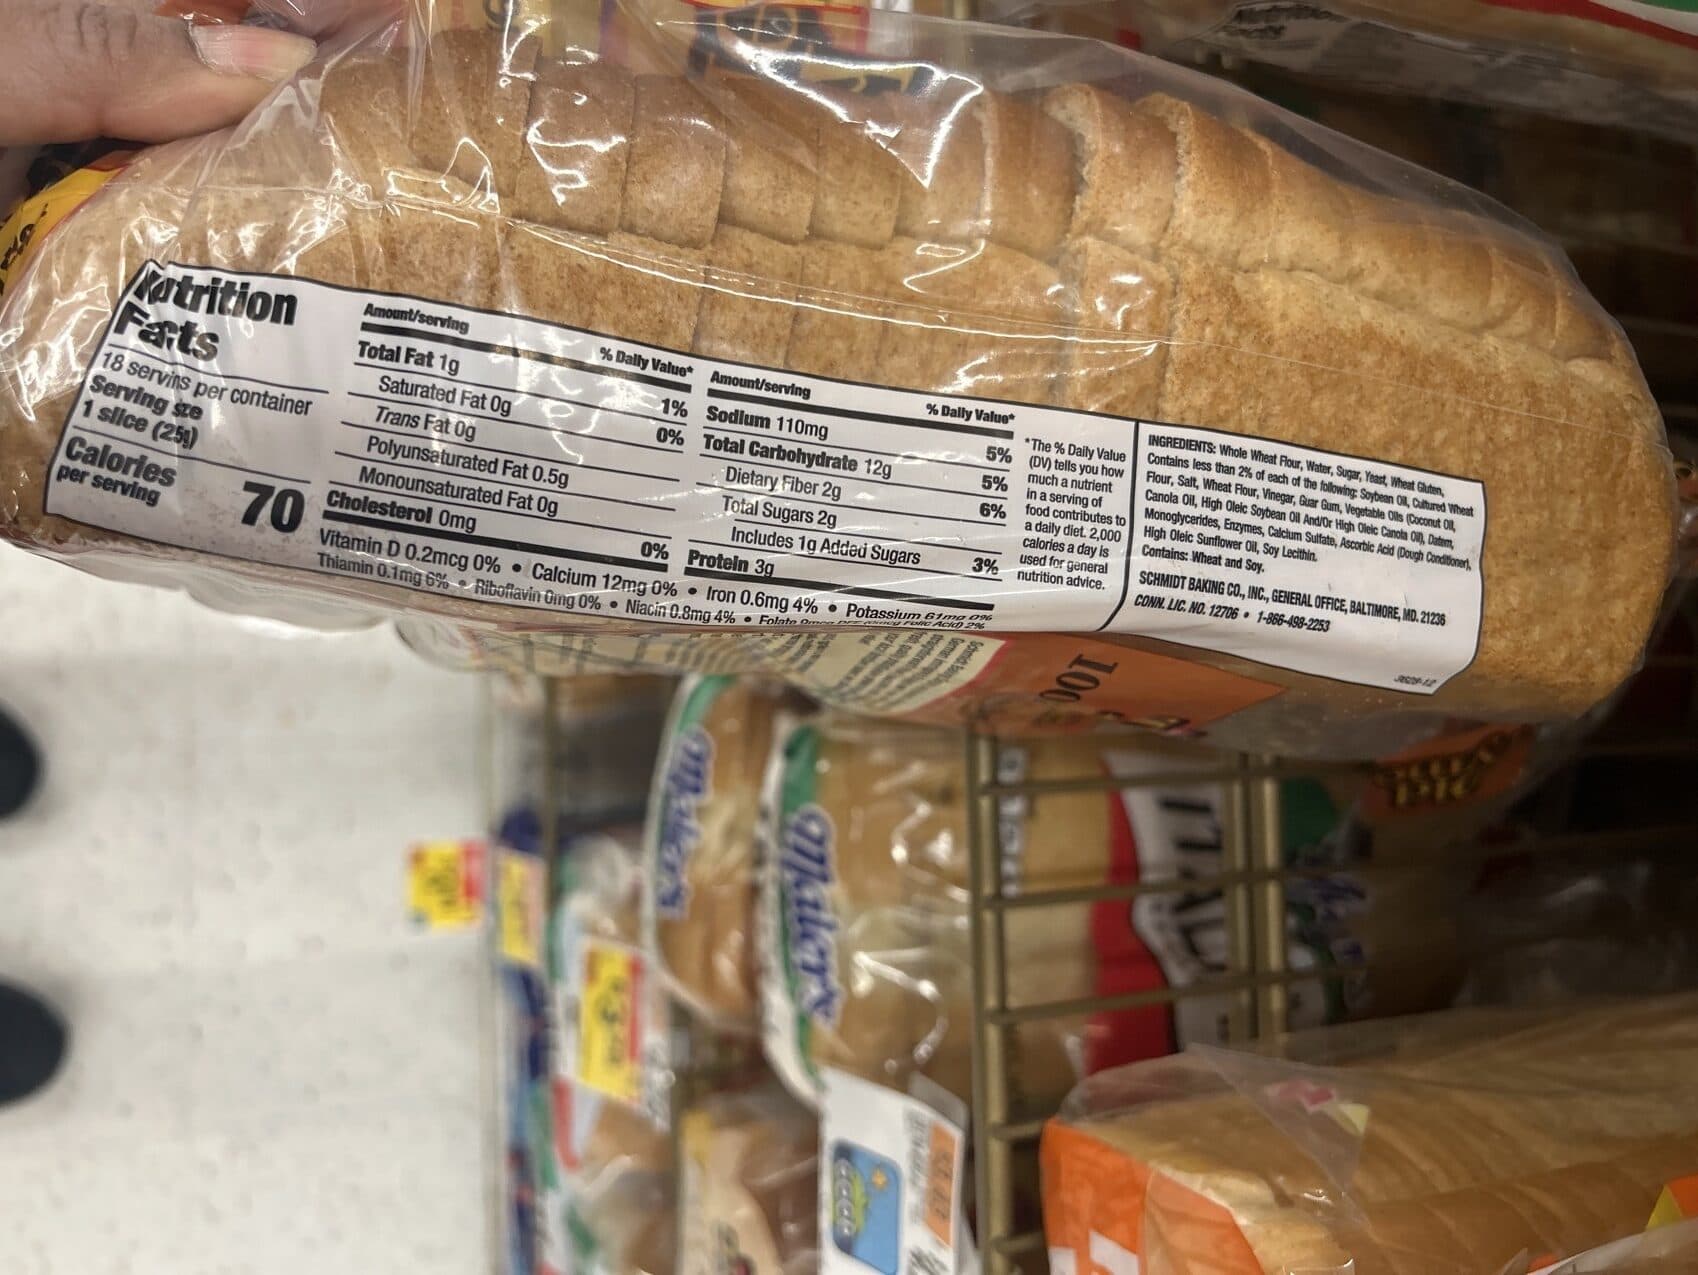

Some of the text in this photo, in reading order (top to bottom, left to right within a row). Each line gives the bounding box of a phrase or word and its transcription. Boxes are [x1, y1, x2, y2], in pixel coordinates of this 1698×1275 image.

[364, 303, 469, 335] Amount/serving
[600, 347, 612, 361] %
[616, 351, 648, 370] Daily
[89, 375, 169, 416] Serving
[102, 352, 124, 371] 18
[193, 382, 228, 401] per
[231, 389, 312, 416] container
[358, 341, 688, 418] Total Fat 1g 1%
[711, 371, 811, 400] Amount/serving
[83, 400, 93, 417] 1
[98, 406, 148, 432] slice
[376, 406, 476, 442] Trans Fat 0g
[379, 376, 684, 446] Saturated Fat 0g 0%
[926, 404, 938, 415] %
[942, 406, 972, 421] Daily
[706, 406, 1012, 463] Sodium 110mg 5%
[1054, 442, 1065, 455] %
[1068, 444, 1094, 460] Daily
[1096, 447, 1126, 462] Value
[66, 436, 177, 487] Calories
[367, 436, 569, 489] Polyunsaturated Fat 0.5g
[704, 434, 1008, 492] Total Carbohydrate 12g 5%
[1029, 456, 1124, 478] (DV) tells you how
[1149, 435, 1444, 497] INGREDIENTS: Whole Wheat Flour, Water, Sugar, Yeast, Wheat Gluten,
[56, 464, 161, 508] per serving
[359, 466, 558, 517] Monounsaturated Fat 0g
[726, 466, 1006, 519] Dietary Fiber 2g 6%
[1027, 488, 1103, 508] in a serving of
[1028, 474, 1112, 493] much a nutrient
[241, 481, 305, 533] 70
[327, 490, 669, 560] Cholesterol 0mg 0%
[722, 495, 837, 529] Total Sugars 2g
[1025, 504, 1126, 526] food contributes to
[731, 527, 998, 575] Includes 1g Added Sugars 3%
[1023, 538, 1109, 558] calories a day is
[1025, 522, 1121, 542] a daily diet. 2,000
[1144, 526, 1317, 561] High Oleic Sunflower Oil, Soy Lecithin.
[320, 528, 382, 551] Vitamin
[388, 540, 400, 557] D
[405, 544, 468, 572] 0.2mcg
[473, 554, 501, 573] 0%
[532, 563, 596, 587] Calcium
[602, 574, 647, 596] 12mg
[652, 581, 677, 597] 0%
[707, 586, 736, 603] Iron
[740, 590, 789, 613] 0.6mg
[793, 597, 818, 614] 4%
[846, 603, 921, 620] Potassium
[688, 549, 774, 576] Protein 3g
[1020, 554, 1107, 574] used for general
[1142, 544, 1264, 574] Contains: Wheat and Soy.
[318, 553, 735, 624] Thiamin 0.1mg 6% Riboflavin 0mg 0% Niacin 0.8mg 4%
[1017, 571, 1105, 590] nutrition advice.
[1139, 571, 1445, 626] SCHMIDT BAKING CO., INC., GENERAL OFFICE, BALTIMORE, MD. 21236
[1134, 594, 1330, 632] CONN. LIC. NO. 12706 1-866-498-2253
[1040, 654, 1119, 702] 100
